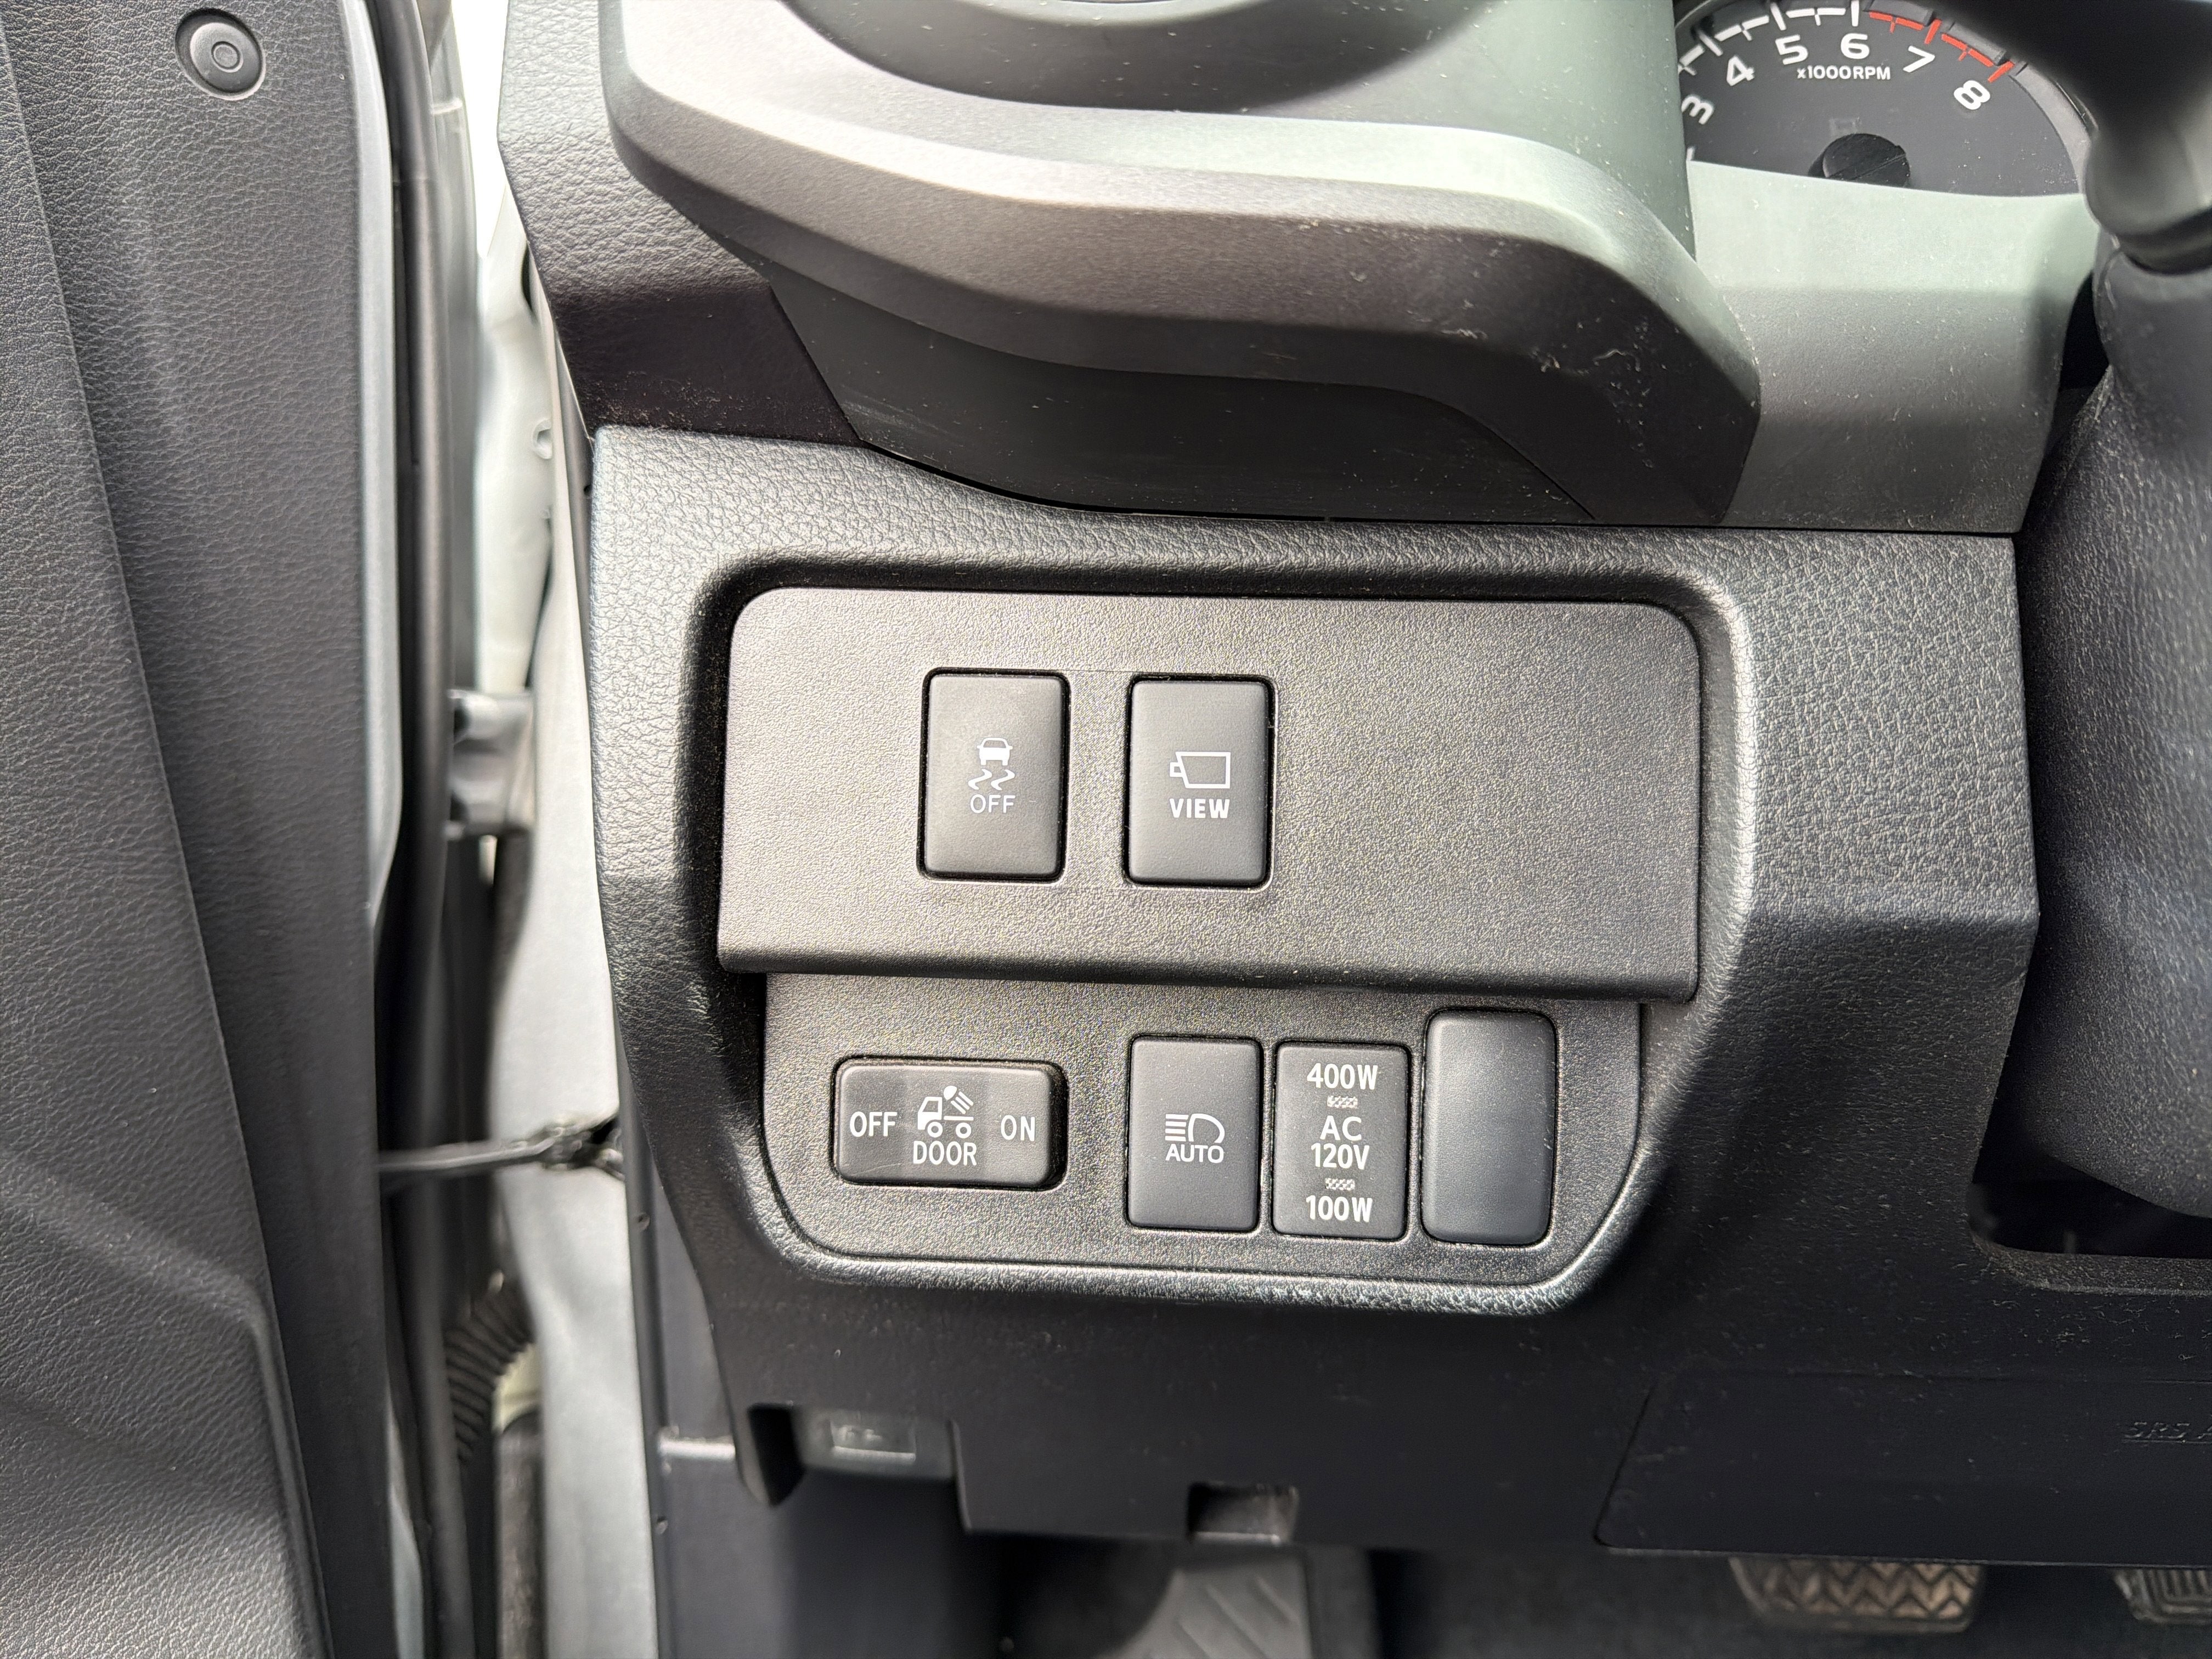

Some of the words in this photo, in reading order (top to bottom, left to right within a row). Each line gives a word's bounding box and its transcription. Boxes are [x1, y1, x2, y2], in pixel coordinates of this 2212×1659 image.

[1681, 94, 1714, 125] 3
[1726, 55, 1754, 86] 4
[1775, 34, 1808, 65] 5
[1840, 33, 1870, 59] 6
[1903, 46, 1936, 73] 7
[1953, 80, 1990, 110] 8
[970, 793, 1015, 814] OFF
[1169, 798, 1230, 819] VIEW
[1306, 1063, 1378, 1090] 400W
[849, 1111, 898, 1137] OFF
[1000, 1114, 1035, 1142] ON
[1319, 1115, 1362, 1141] AC
[912, 1141, 977, 1166] DOOR
[1165, 1143, 1224, 1164] AUTO
[1311, 1143, 1370, 1170] 120V
[1306, 1195, 1373, 1223] 100W
